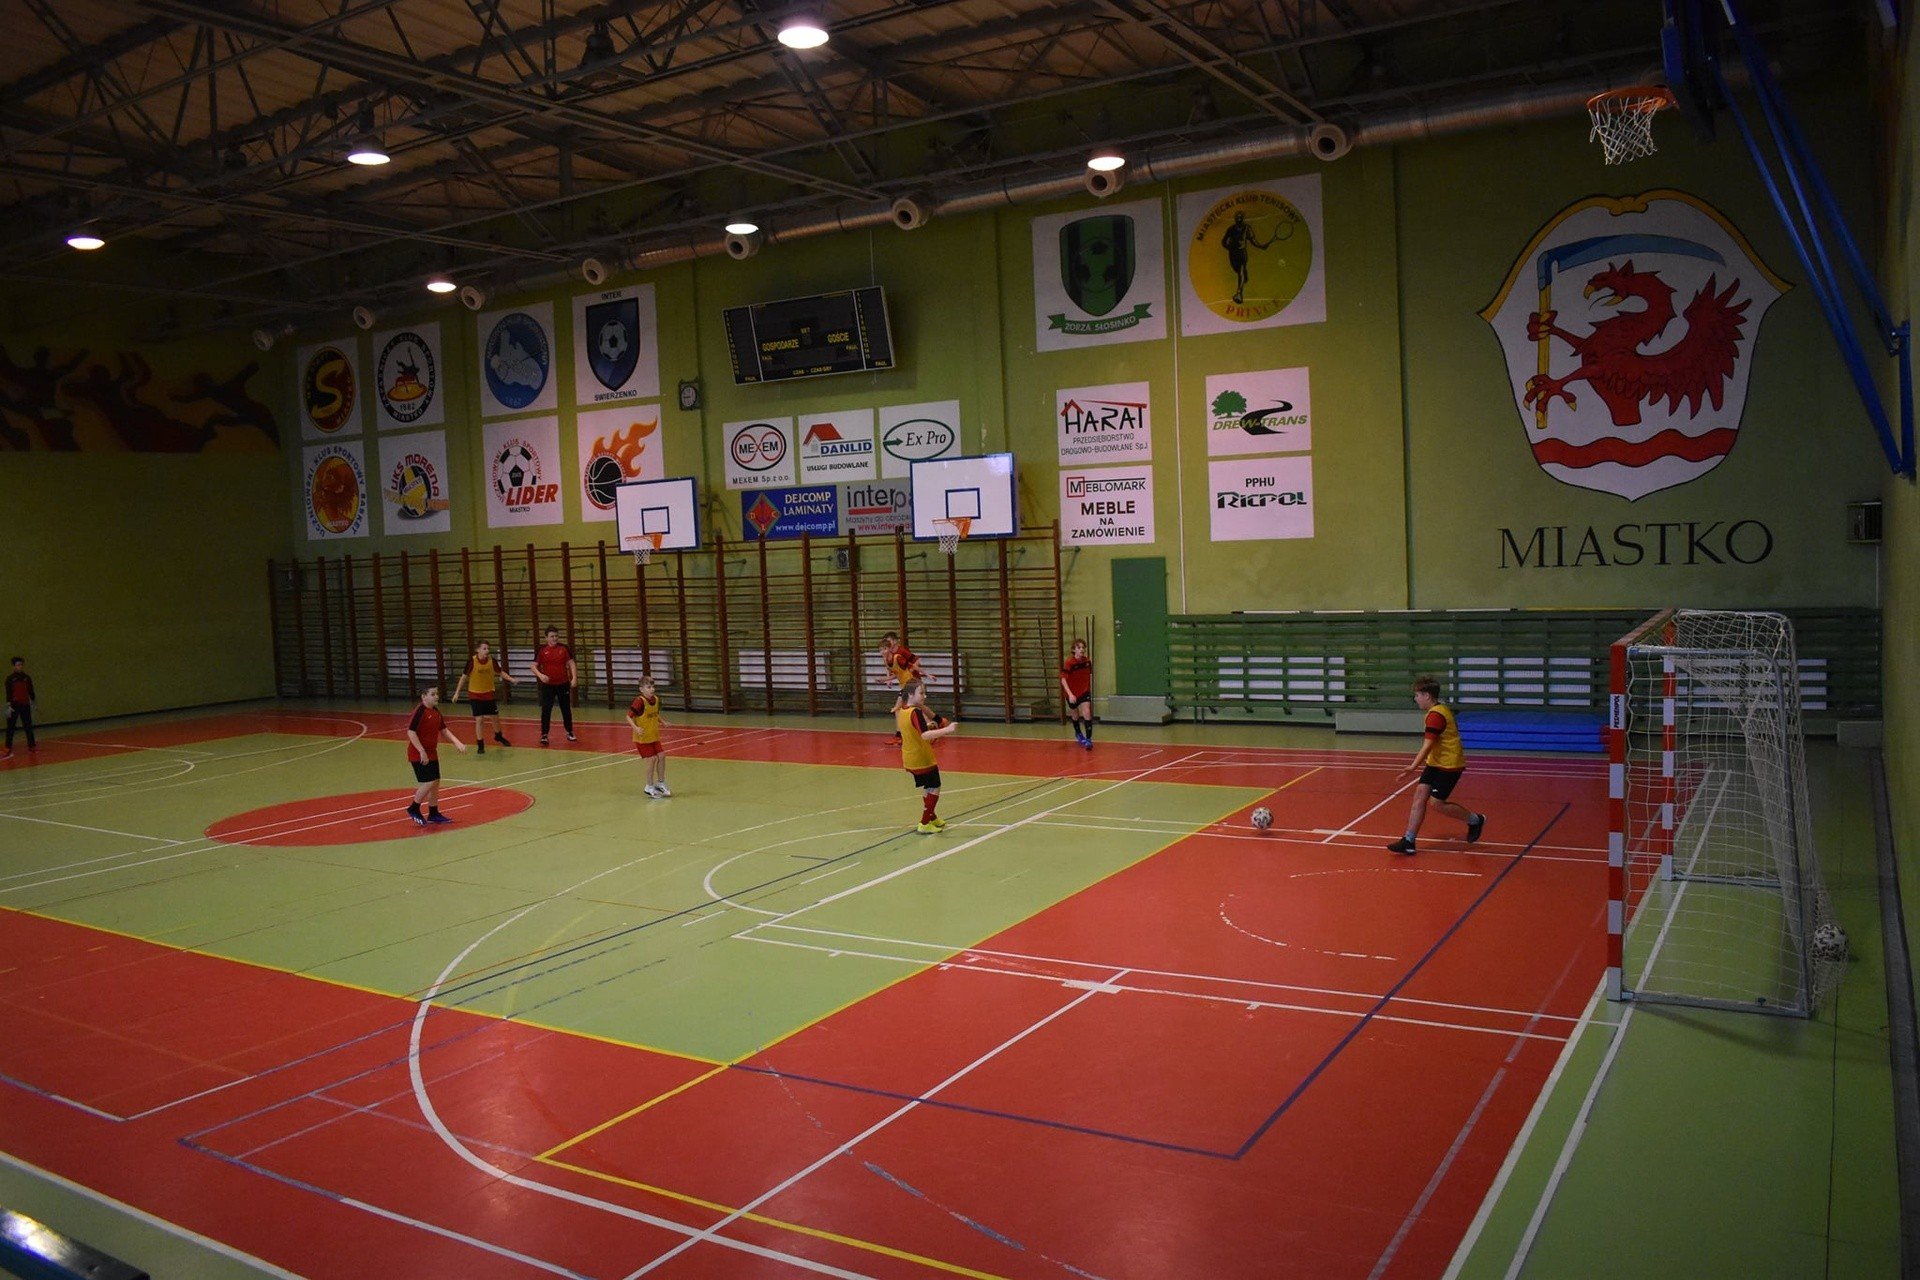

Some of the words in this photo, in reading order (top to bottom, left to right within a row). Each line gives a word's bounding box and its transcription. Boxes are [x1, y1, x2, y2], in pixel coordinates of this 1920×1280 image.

[602, 291, 622, 300] INTER
[1065, 322, 1092, 332] ZORZA
[761, 338, 800, 352] GOSPODARZE
[1061, 400, 1147, 435] HARAT
[906, 432, 922, 446] Ex
[927, 430, 946, 444] Pro
[739, 440, 779, 455] MEXEM
[821, 442, 872, 455] DANLID
[830, 461, 869, 471] BUDOWLANE
[391, 461, 405, 491] UKS
[733, 476, 759, 484] MEXEM
[1245, 477, 1275, 487] PPHU
[1069, 480, 1146, 493] MEBLOMARK
[506, 484, 558, 506] LIDER
[785, 492, 832, 504] DEJCOMP
[783, 504, 834, 516] LAMINATY
[1081, 500, 1135, 515] MEBLE
[1497, 519, 1774, 569] MIASTKO
